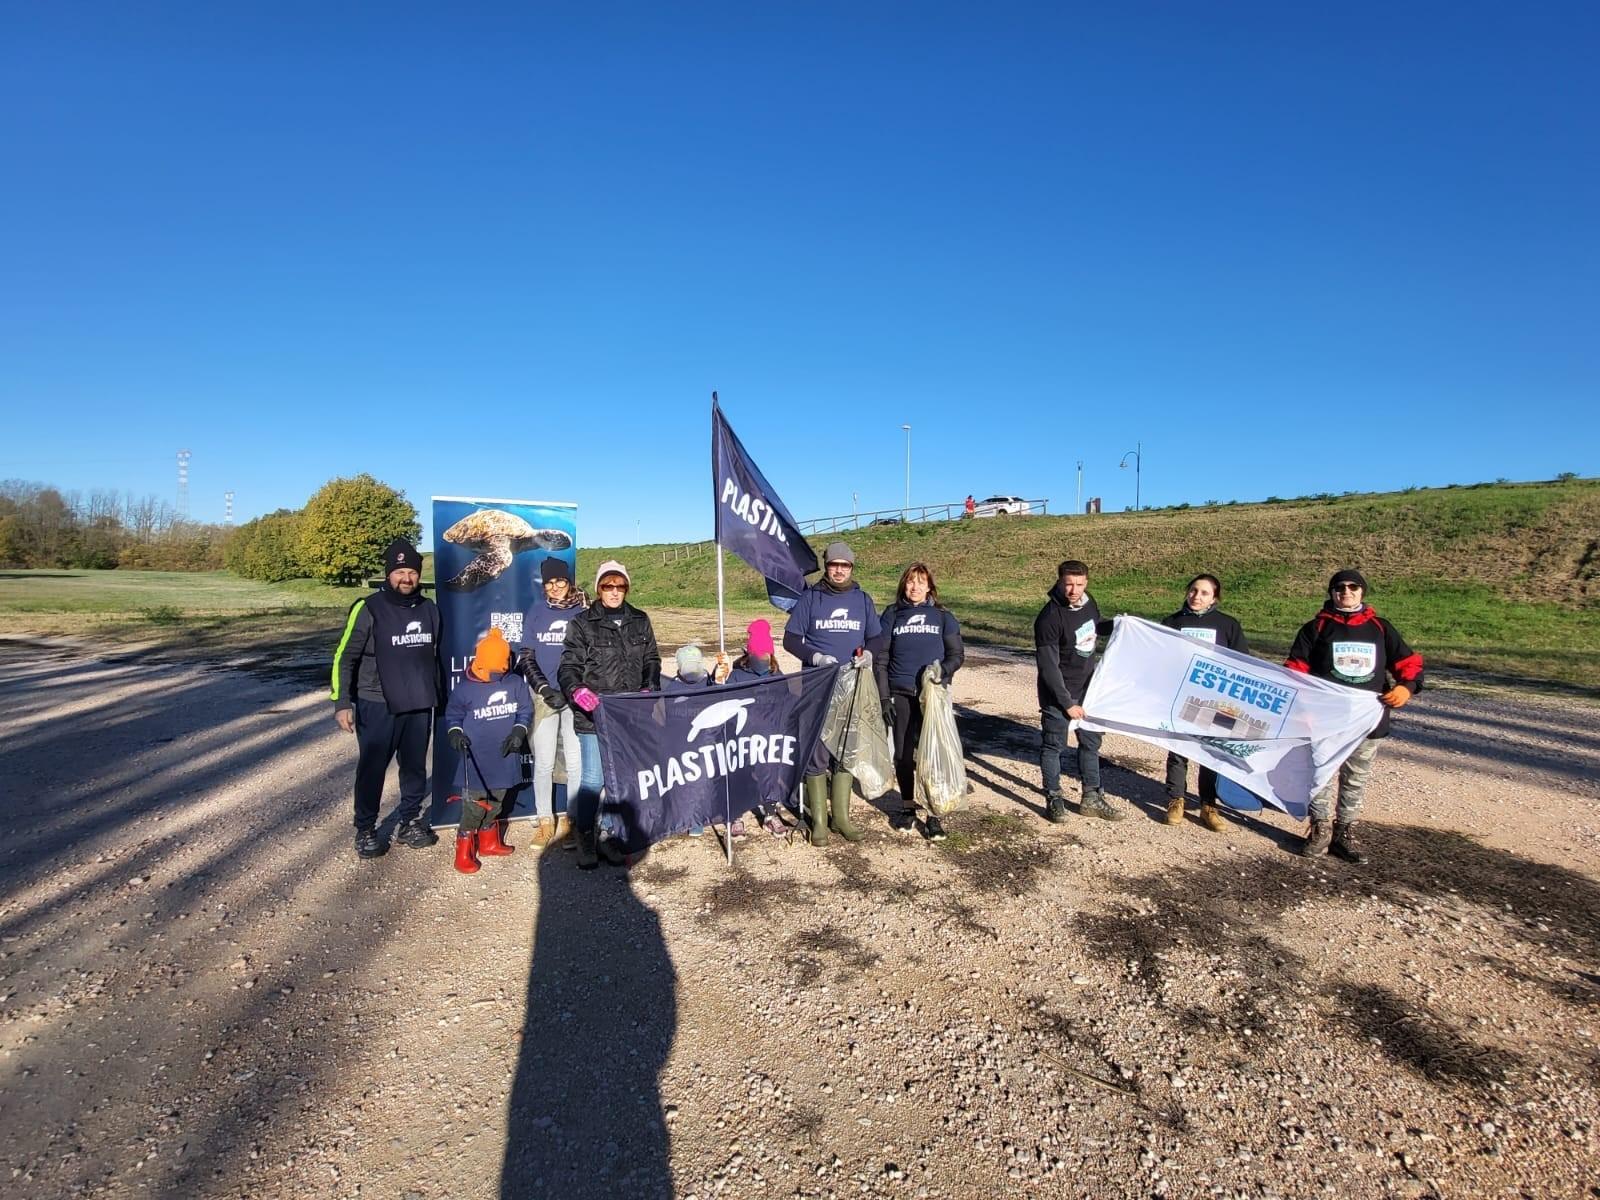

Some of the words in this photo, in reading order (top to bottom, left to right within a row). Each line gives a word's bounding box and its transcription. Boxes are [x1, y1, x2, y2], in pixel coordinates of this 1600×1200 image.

[1189, 668, 1287, 716] ESTENSE
[1195, 660, 1227, 677] DIFESA
[1229, 672, 1290, 698] AMBIENTALE
[637, 734, 797, 801] PLASTICFREE
